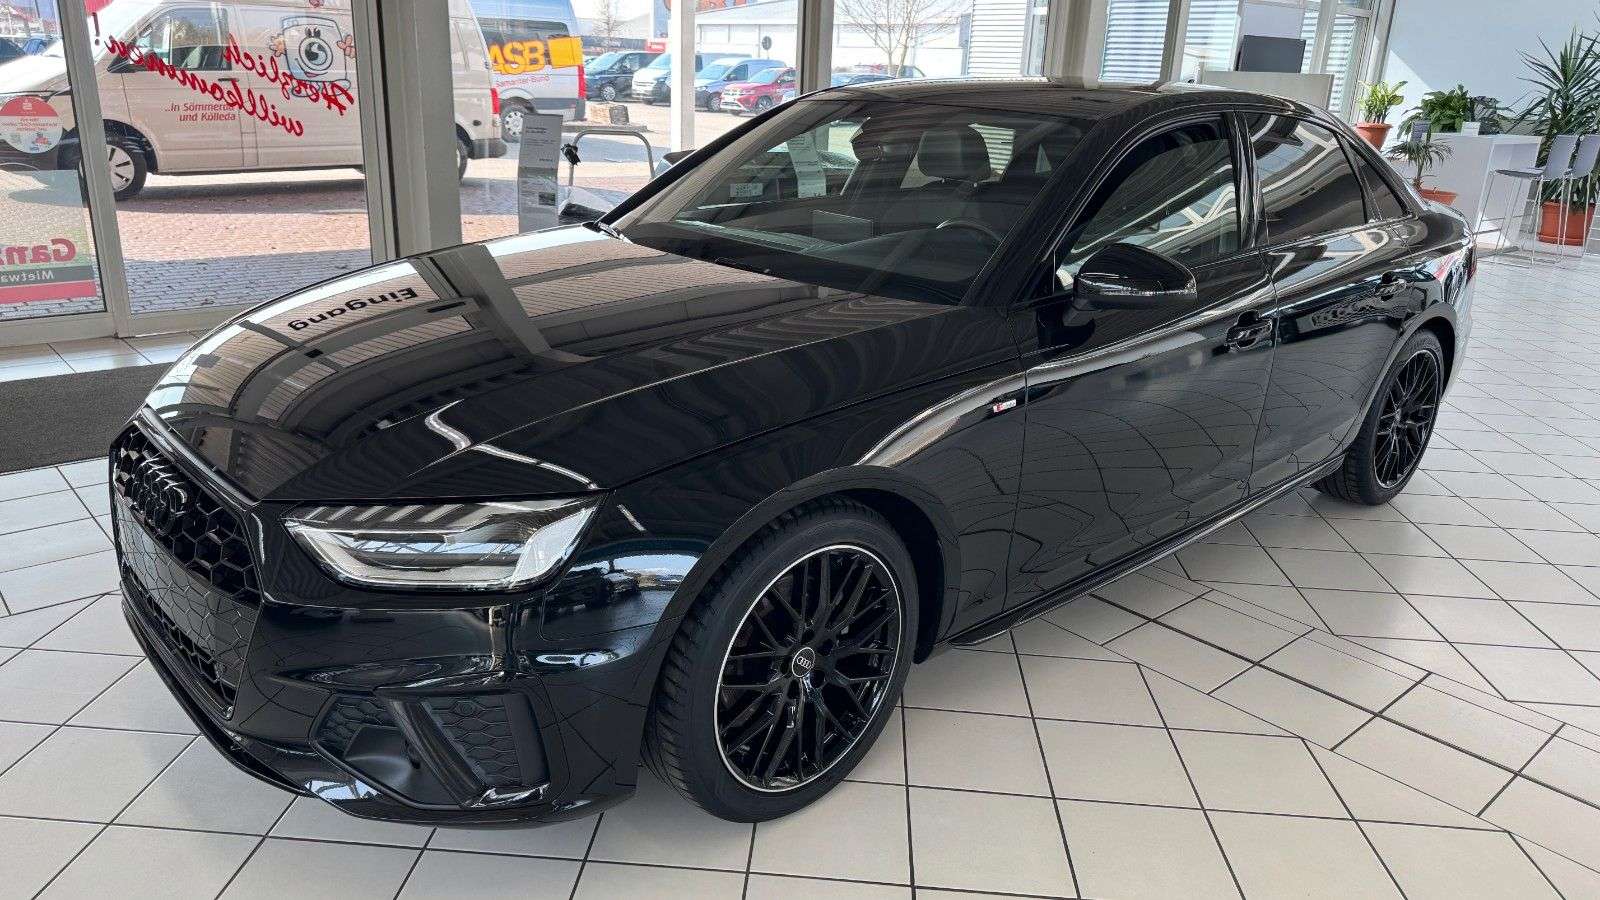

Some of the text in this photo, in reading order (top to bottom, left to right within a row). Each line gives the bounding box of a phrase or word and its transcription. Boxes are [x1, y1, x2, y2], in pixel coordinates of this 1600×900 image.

[489, 40, 546, 75] ASB
[179, 112, 198, 121] und
[287, 287, 418, 331] Eingang
